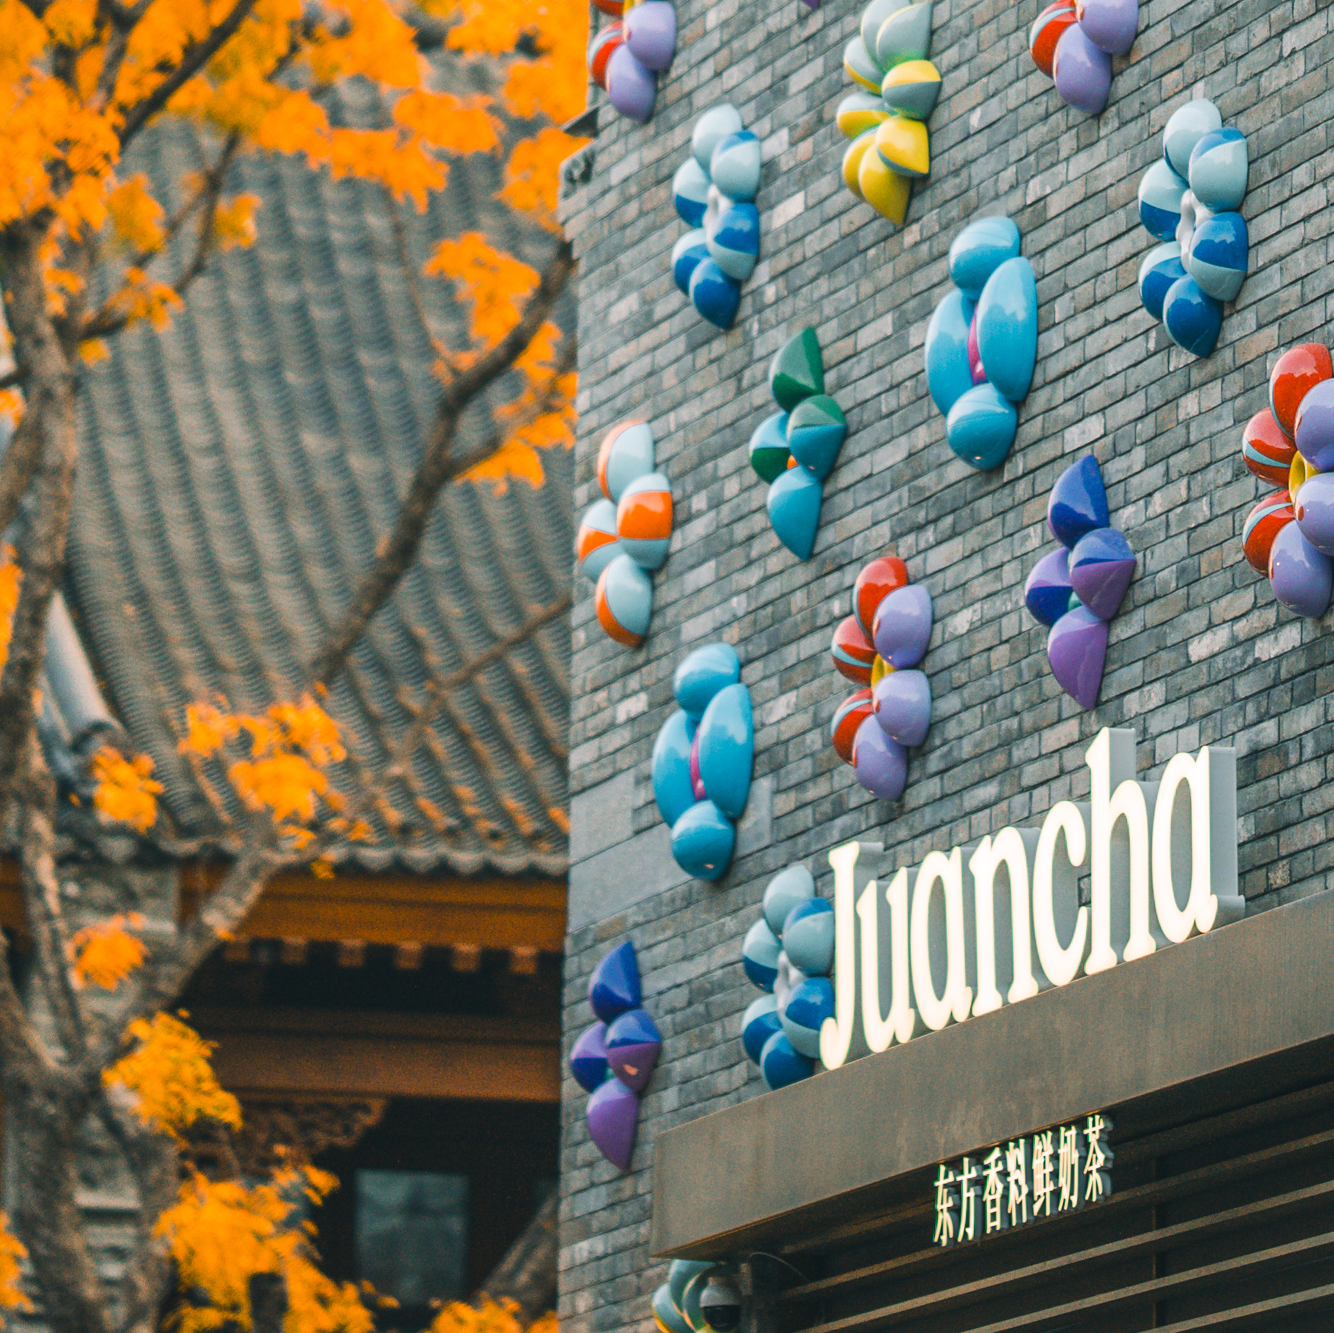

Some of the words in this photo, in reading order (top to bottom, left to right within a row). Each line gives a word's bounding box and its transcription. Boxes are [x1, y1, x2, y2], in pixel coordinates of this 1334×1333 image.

[820, 726, 1219, 1071] Juancha
[933, 1114, 1105, 1247] 东方香料鲜奶茶
